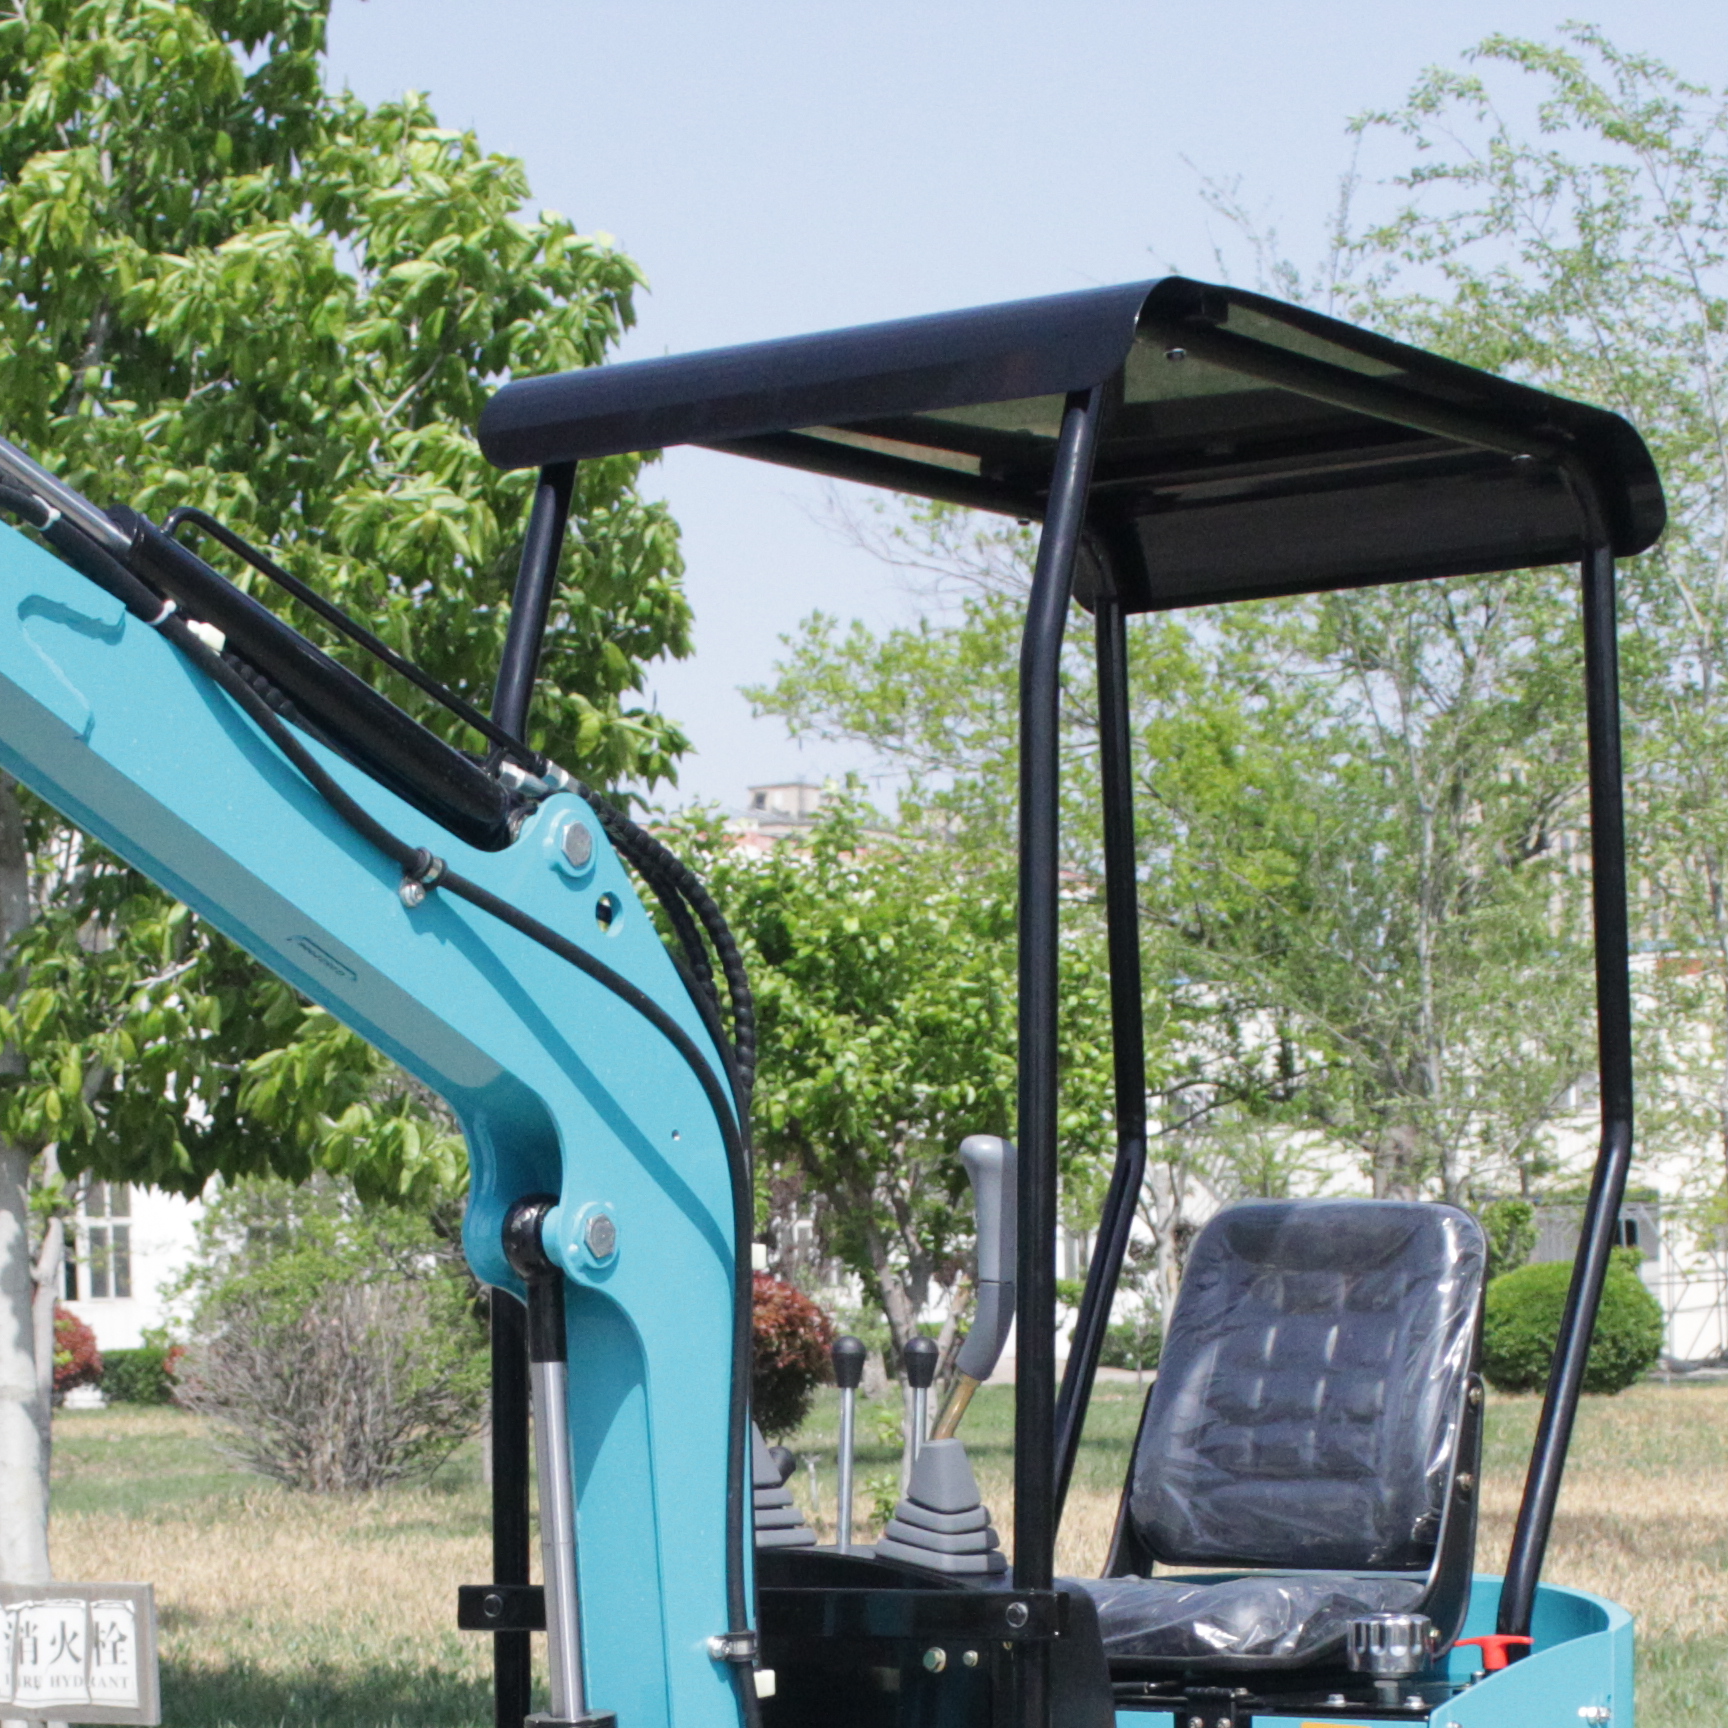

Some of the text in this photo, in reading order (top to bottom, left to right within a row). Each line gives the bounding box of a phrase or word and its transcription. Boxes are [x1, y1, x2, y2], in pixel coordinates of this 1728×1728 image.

[4, 1620, 128, 1667] 消火栓
[50, 1675, 129, 1689] HYDRANT
